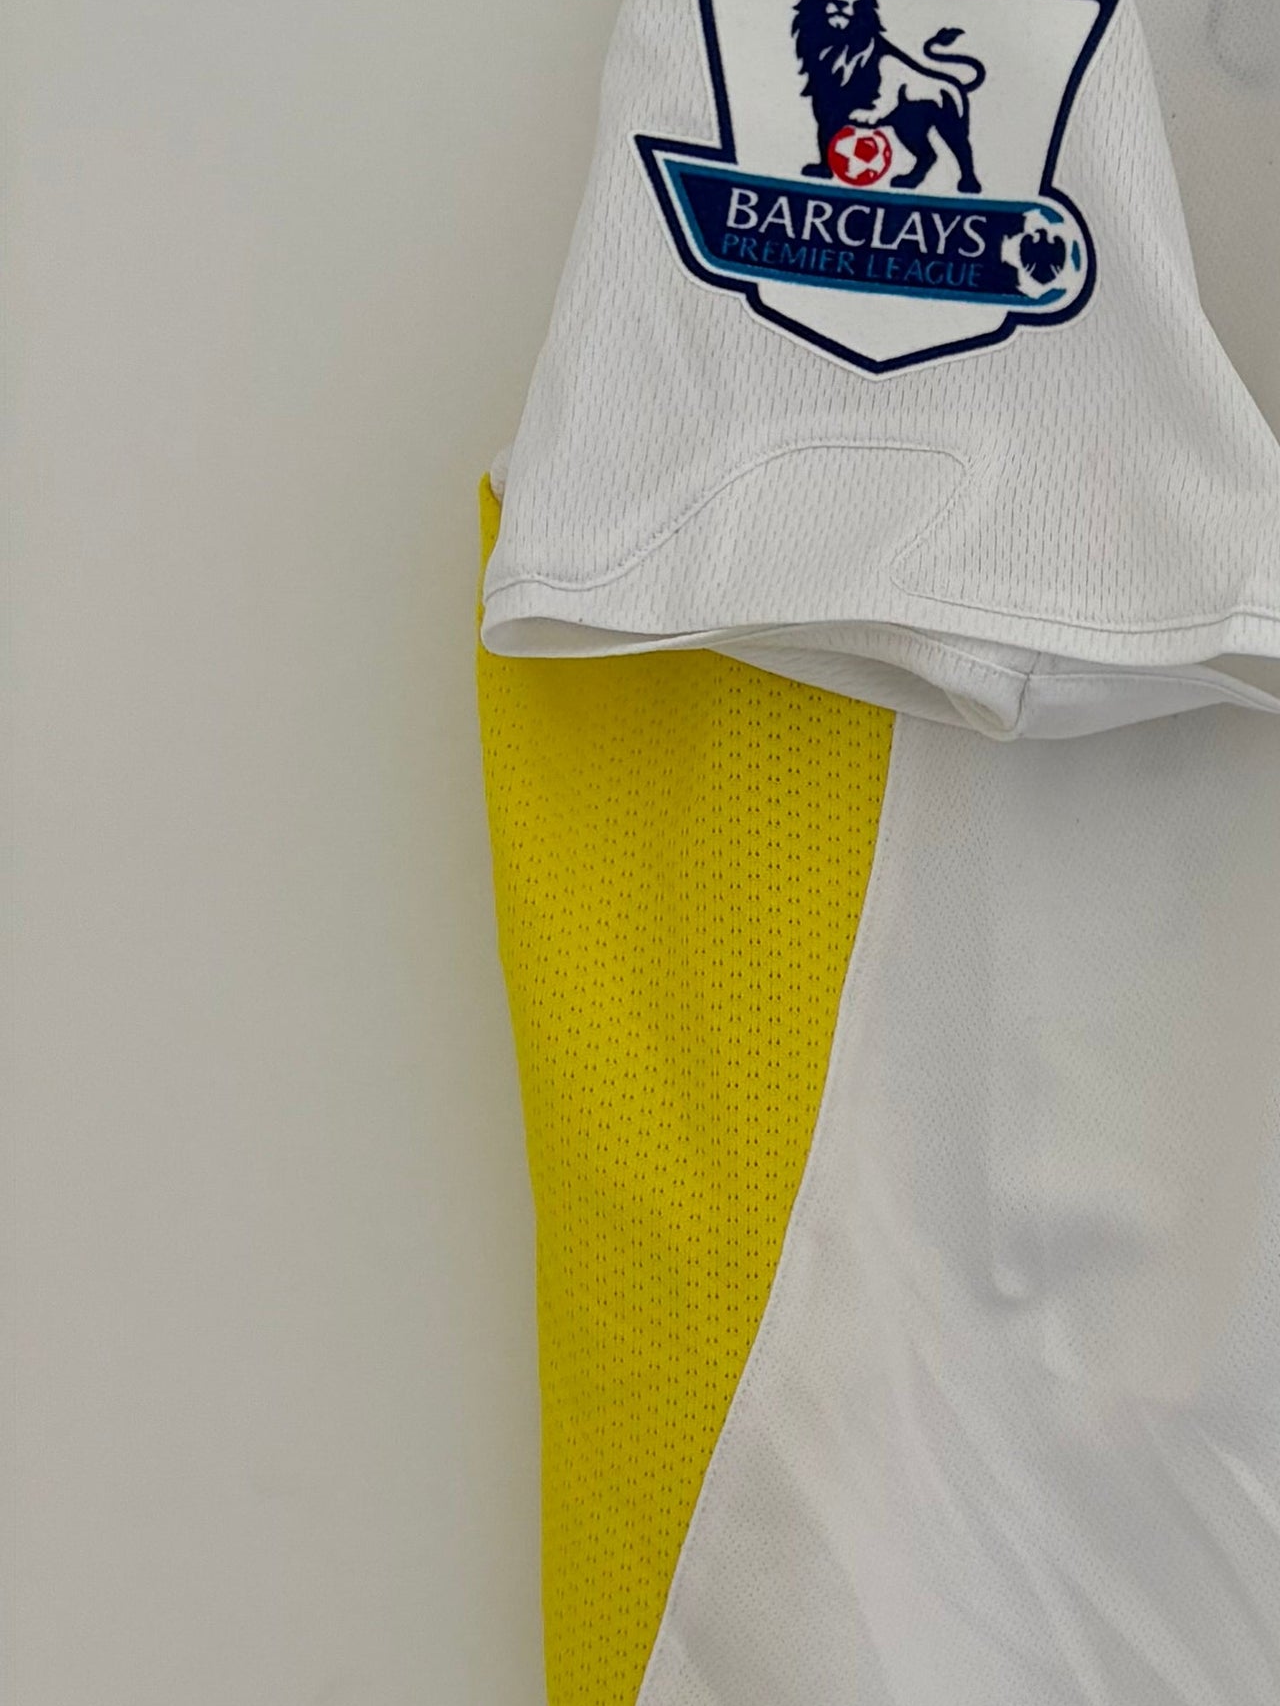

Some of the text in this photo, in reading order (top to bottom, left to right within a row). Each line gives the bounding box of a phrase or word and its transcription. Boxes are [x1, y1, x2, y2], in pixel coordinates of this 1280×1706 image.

[726, 188, 987, 257] BARCLAYS
[722, 234, 984, 287] PREMIER LEAGUE
